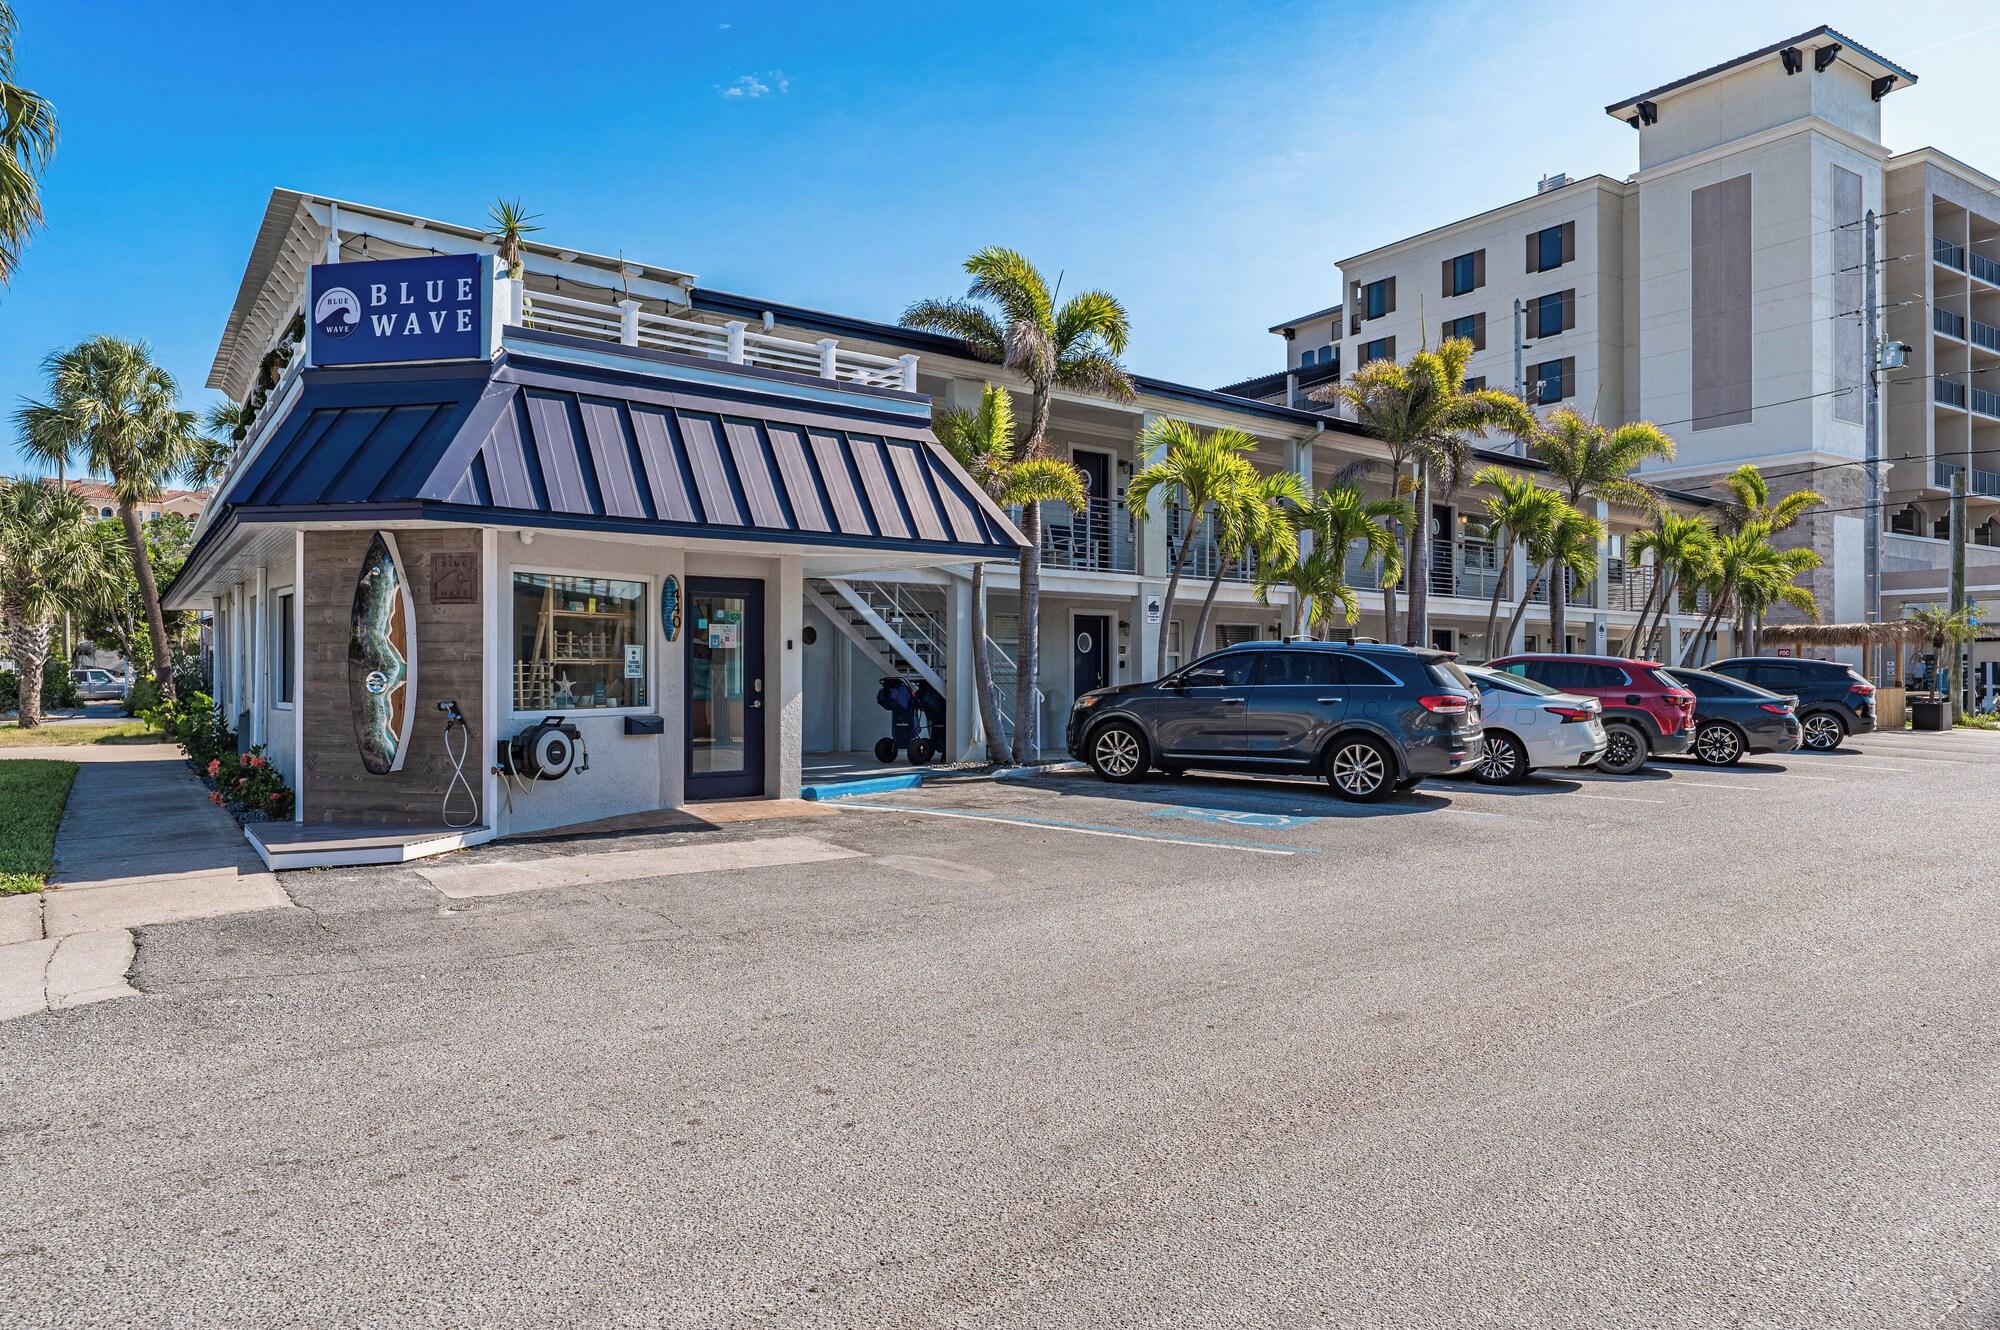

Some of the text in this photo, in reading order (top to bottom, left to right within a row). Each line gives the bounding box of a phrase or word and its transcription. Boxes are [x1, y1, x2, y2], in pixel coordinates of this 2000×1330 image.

[327, 297, 349, 305] BLUE
[370, 278, 473, 306] BLUE
[326, 325, 350, 334] WAVE
[370, 309, 472, 337] WAVE
[672, 589, 681, 629] 440
